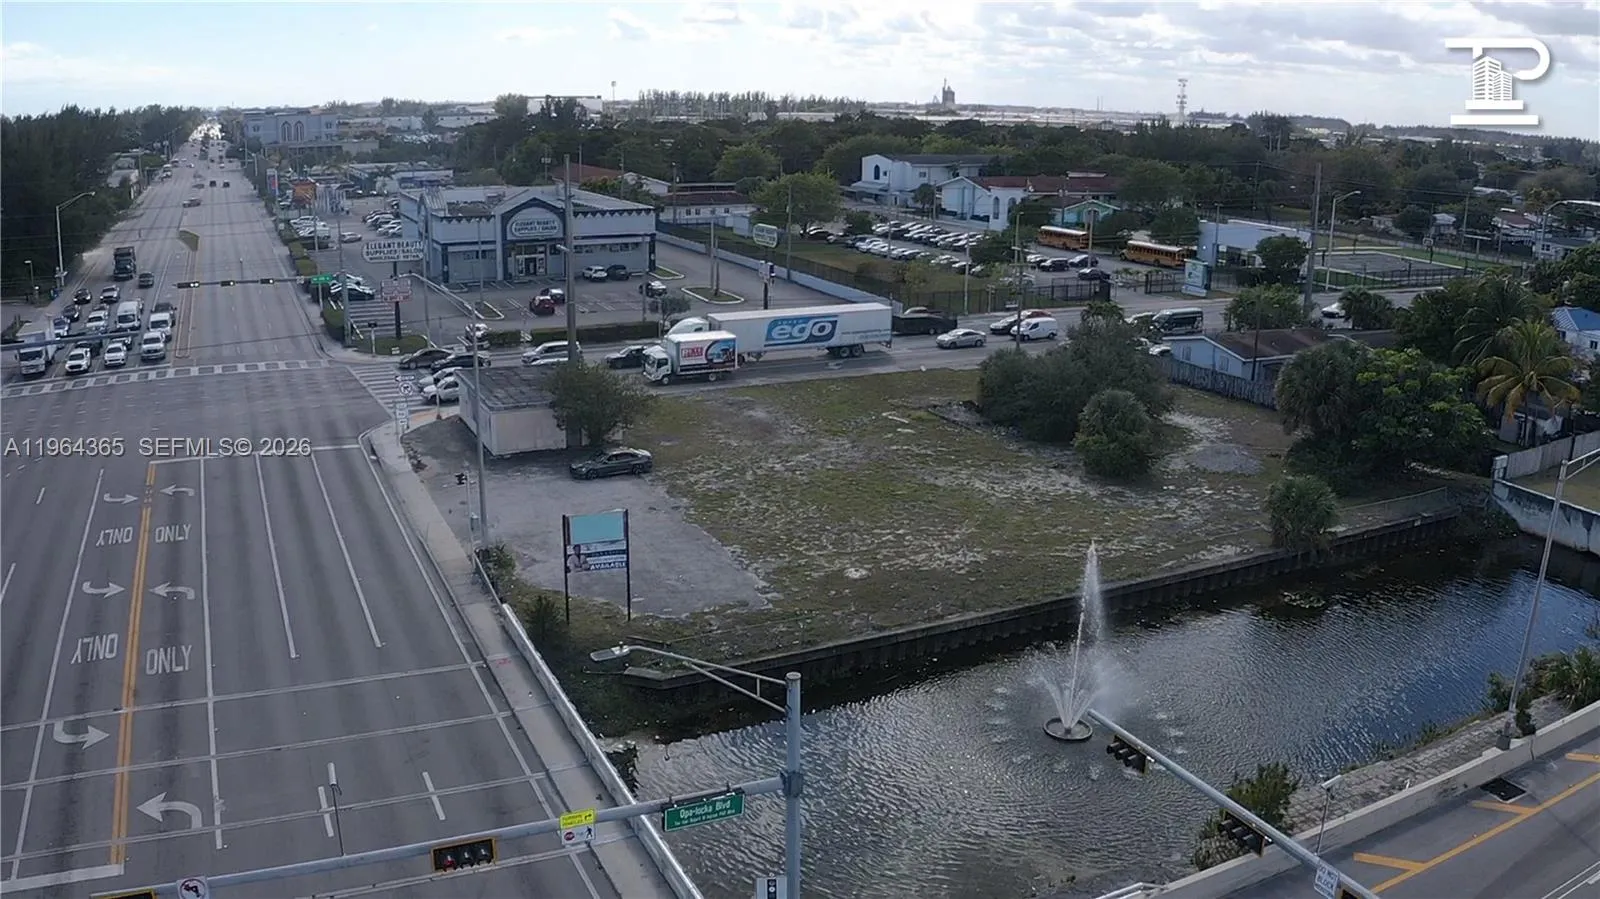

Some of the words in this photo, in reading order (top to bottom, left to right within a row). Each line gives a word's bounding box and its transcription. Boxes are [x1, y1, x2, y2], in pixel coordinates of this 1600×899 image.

[366, 241, 396, 250] ELEGANT
[397, 240, 423, 249] BEAUTY
[96, 527, 133, 547] ONLY
[155, 524, 192, 543] ONLY
[590, 561, 626, 570] AVAILABLE
[71, 633, 119, 665] ONLY
[146, 645, 193, 675] ONLY
[680, 804, 713, 819] Opa-locka
[715, 799, 731, 811] Blvd
